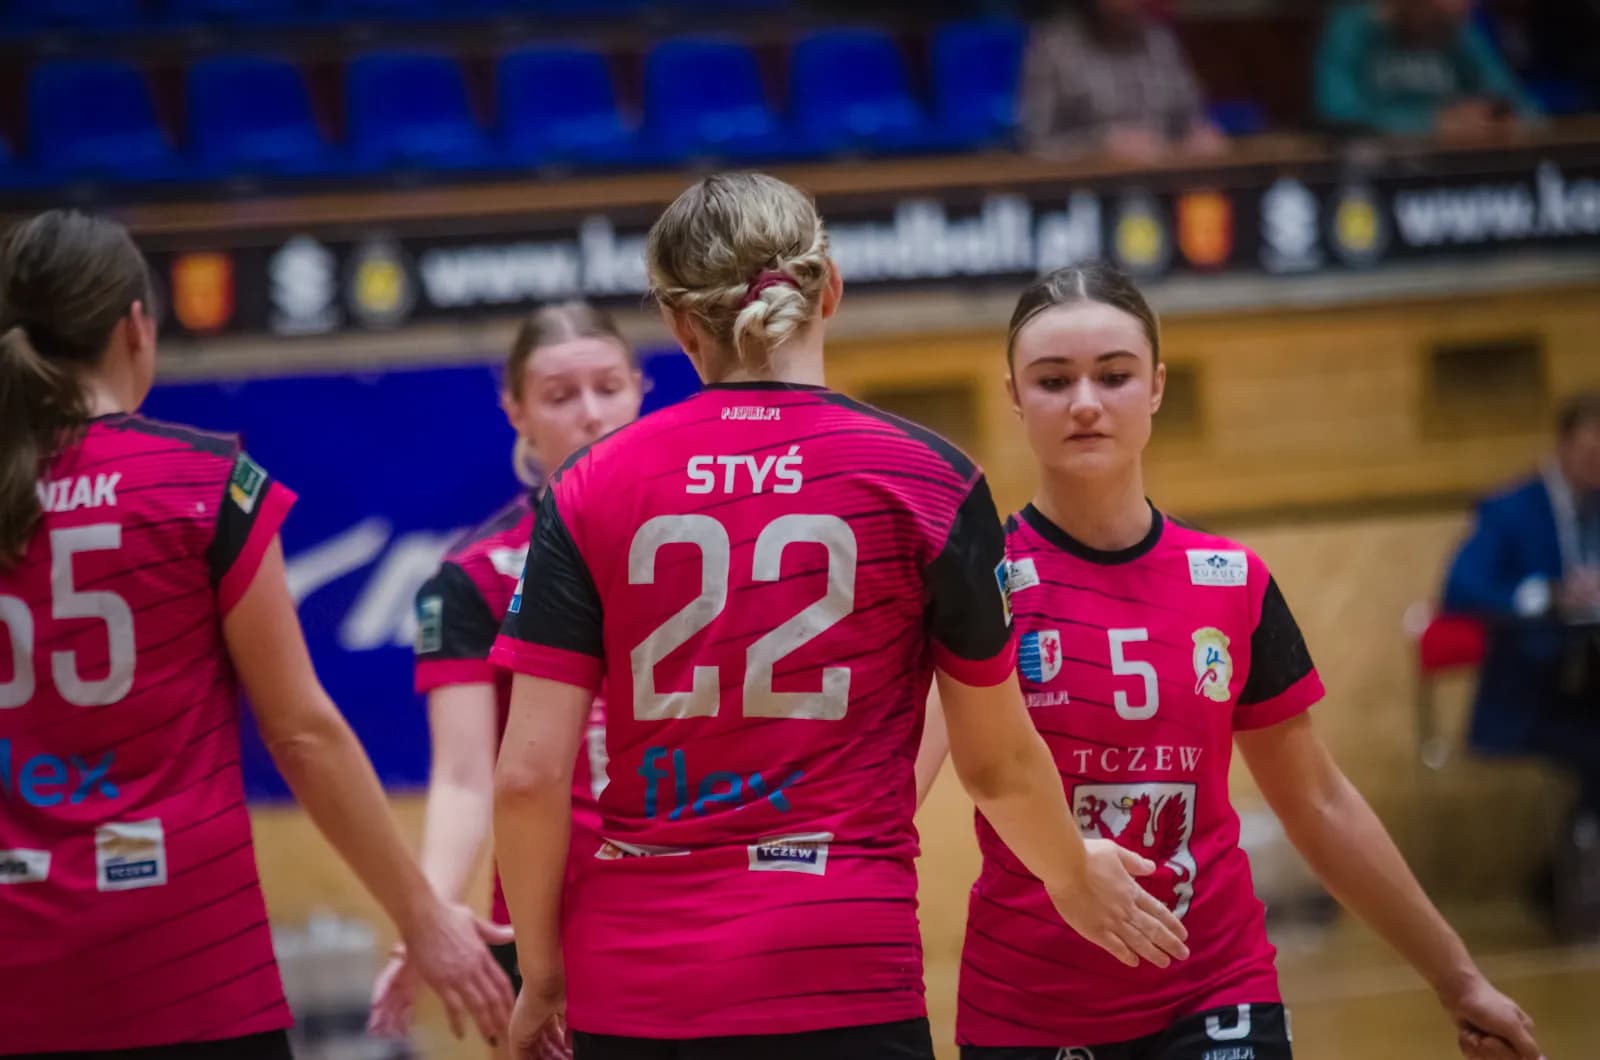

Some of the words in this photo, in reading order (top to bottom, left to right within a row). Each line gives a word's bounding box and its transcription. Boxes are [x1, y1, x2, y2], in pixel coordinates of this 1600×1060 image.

[686, 445, 803, 494] STYŚ
[628, 514, 857, 720] 22
[1107, 628, 1159, 720] 5
[1073, 746, 1202, 773] TCZEW
[761, 846, 813, 859] TCZEW
